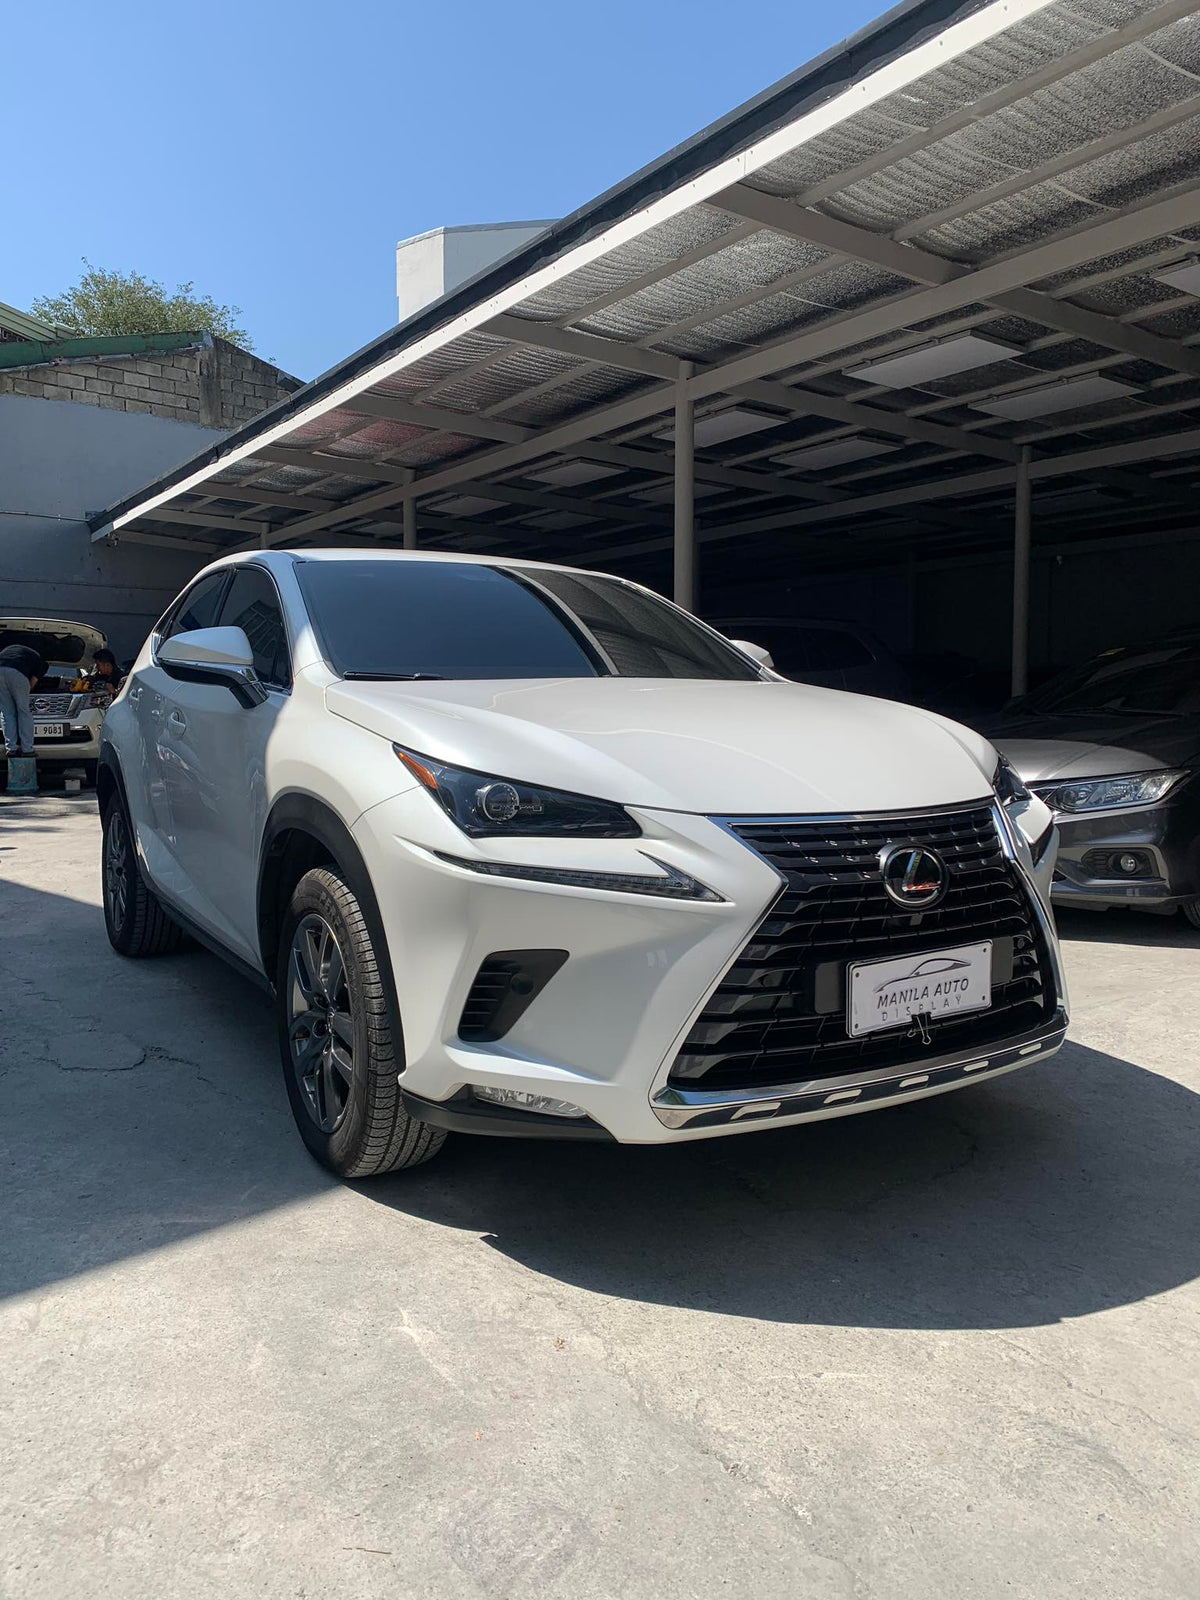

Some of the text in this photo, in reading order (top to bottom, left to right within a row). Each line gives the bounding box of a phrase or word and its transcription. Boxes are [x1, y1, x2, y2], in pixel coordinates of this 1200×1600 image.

[877, 978, 969, 1009] MANILA AUTO
[882, 995, 962, 1021] DISPLAY
